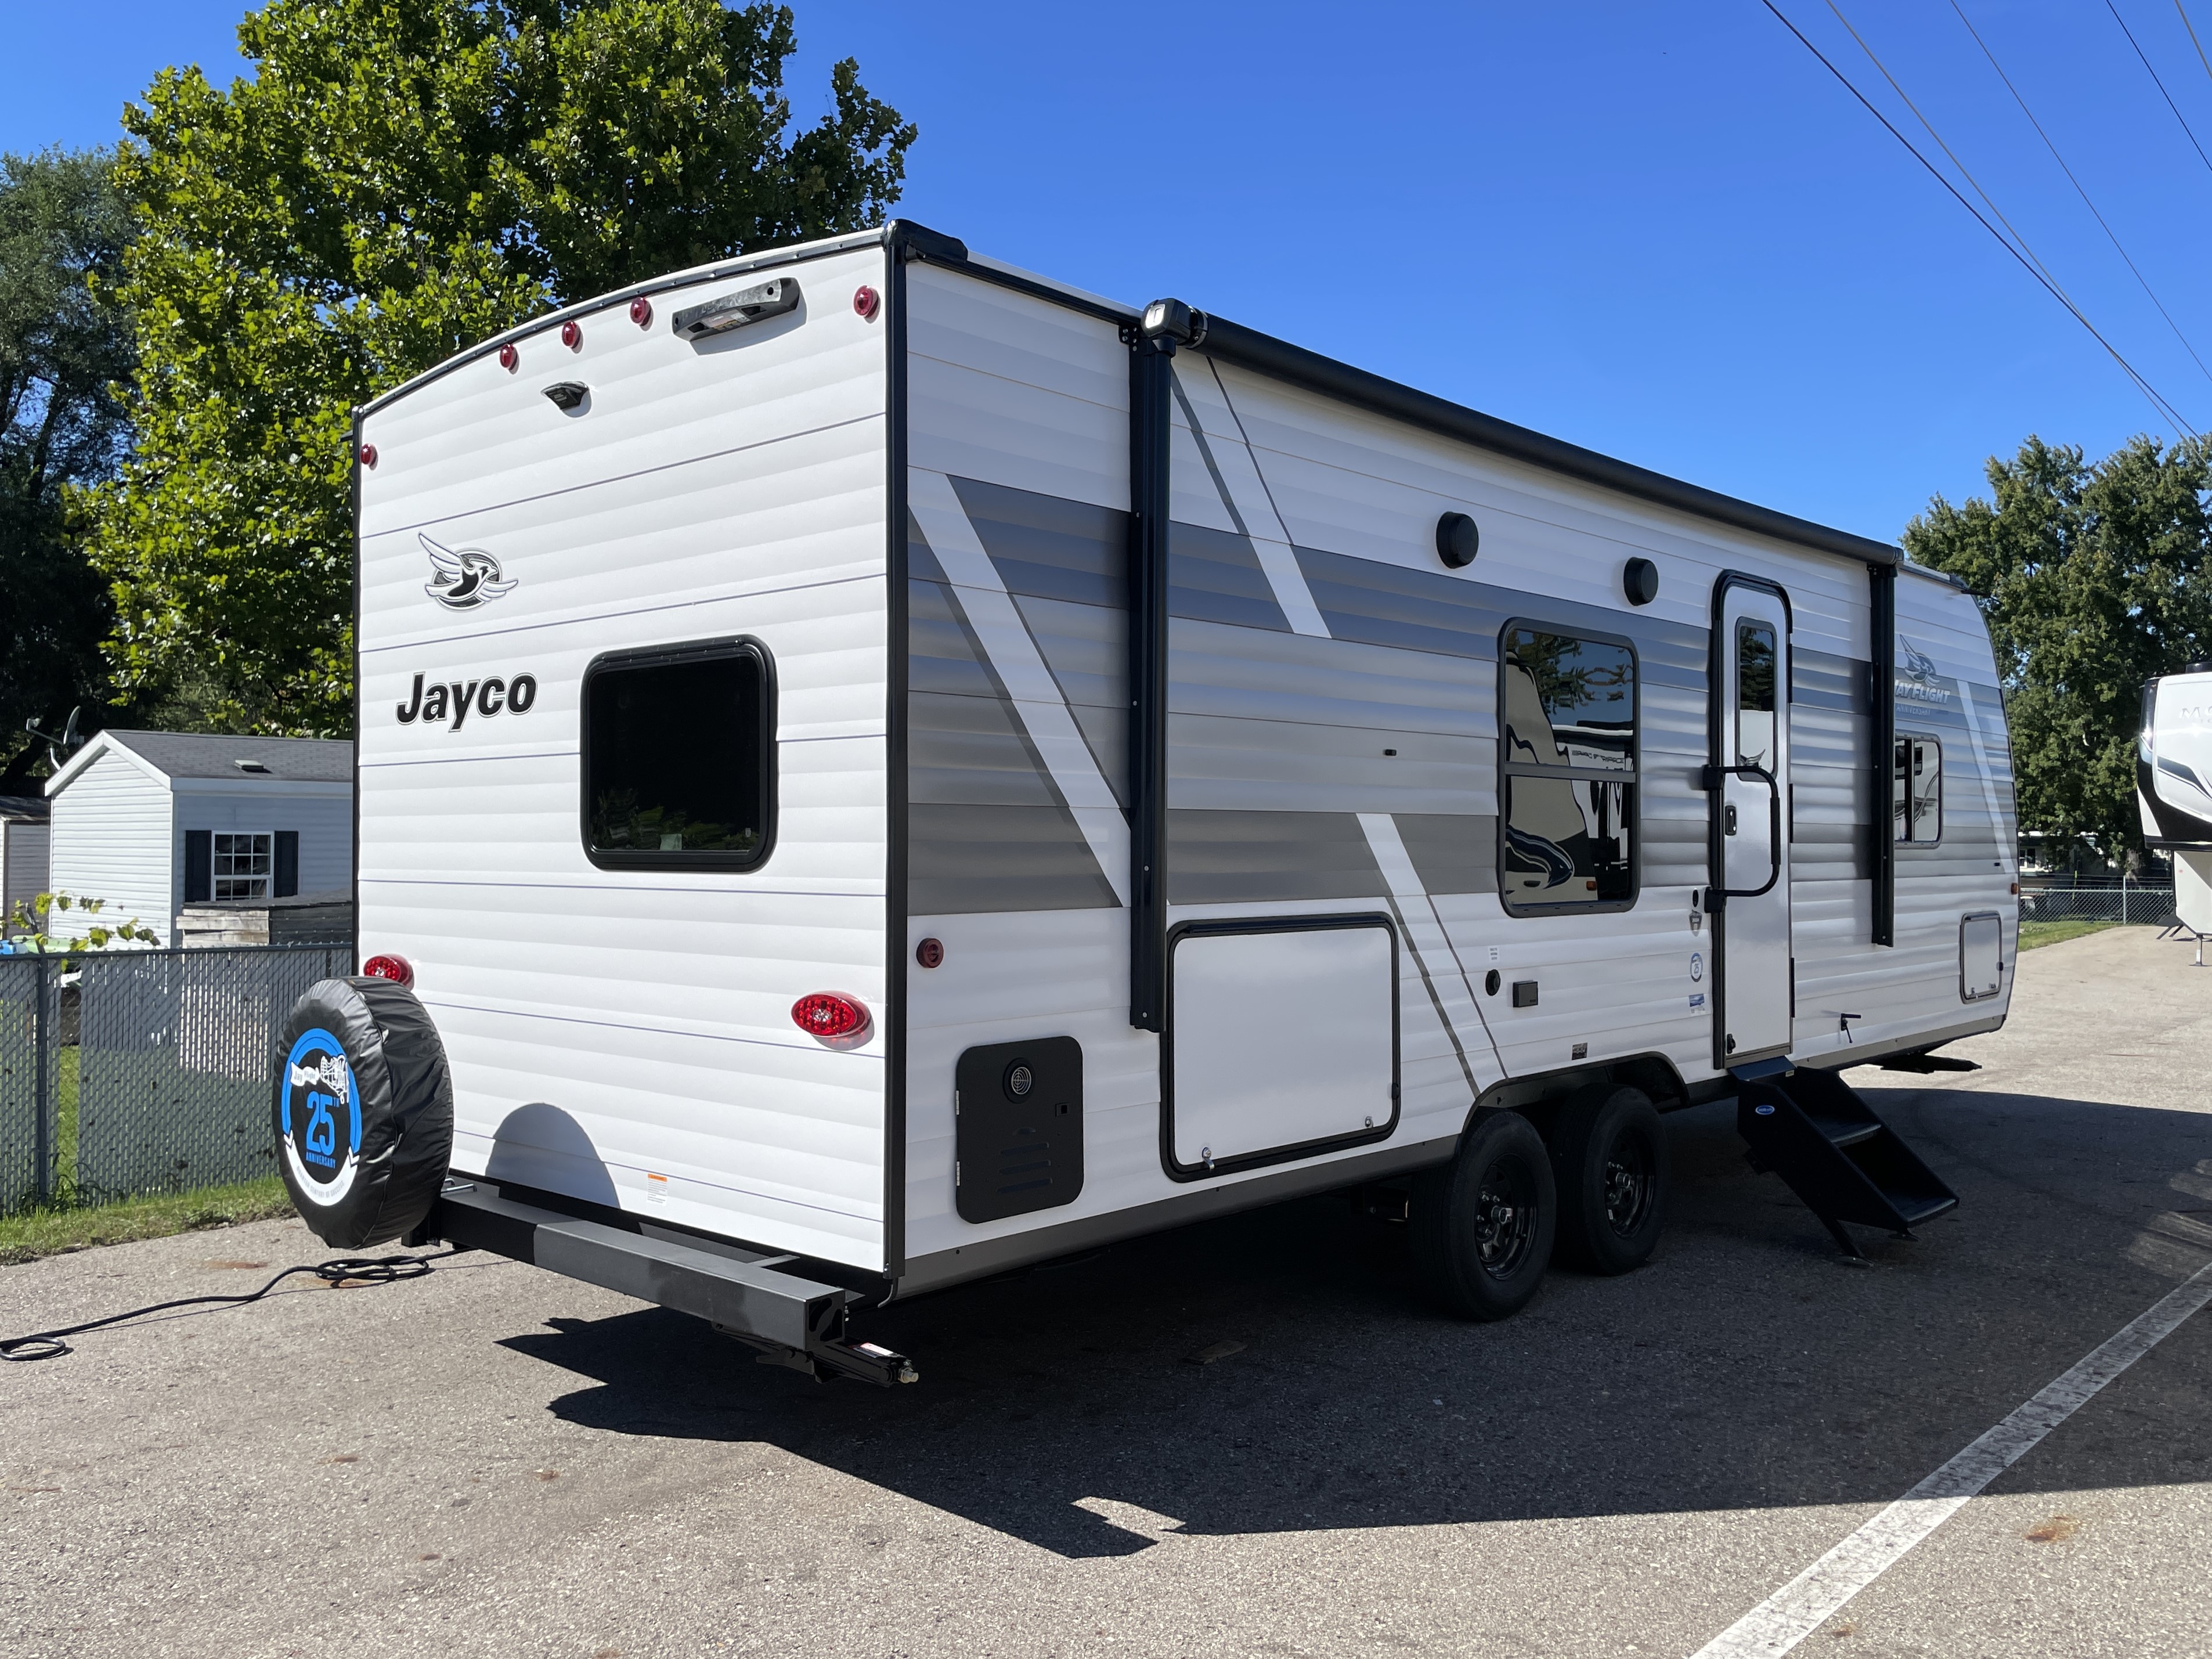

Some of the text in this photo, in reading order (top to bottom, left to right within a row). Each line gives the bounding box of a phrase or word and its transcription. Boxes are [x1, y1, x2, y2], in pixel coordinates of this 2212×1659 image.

[396, 672, 537, 733] Jayco
[1896, 706, 1931, 716] ANNIVERSARY
[294, 1070, 302, 1083] Jay
[306, 1152, 336, 1168] ANNIVERSARY
